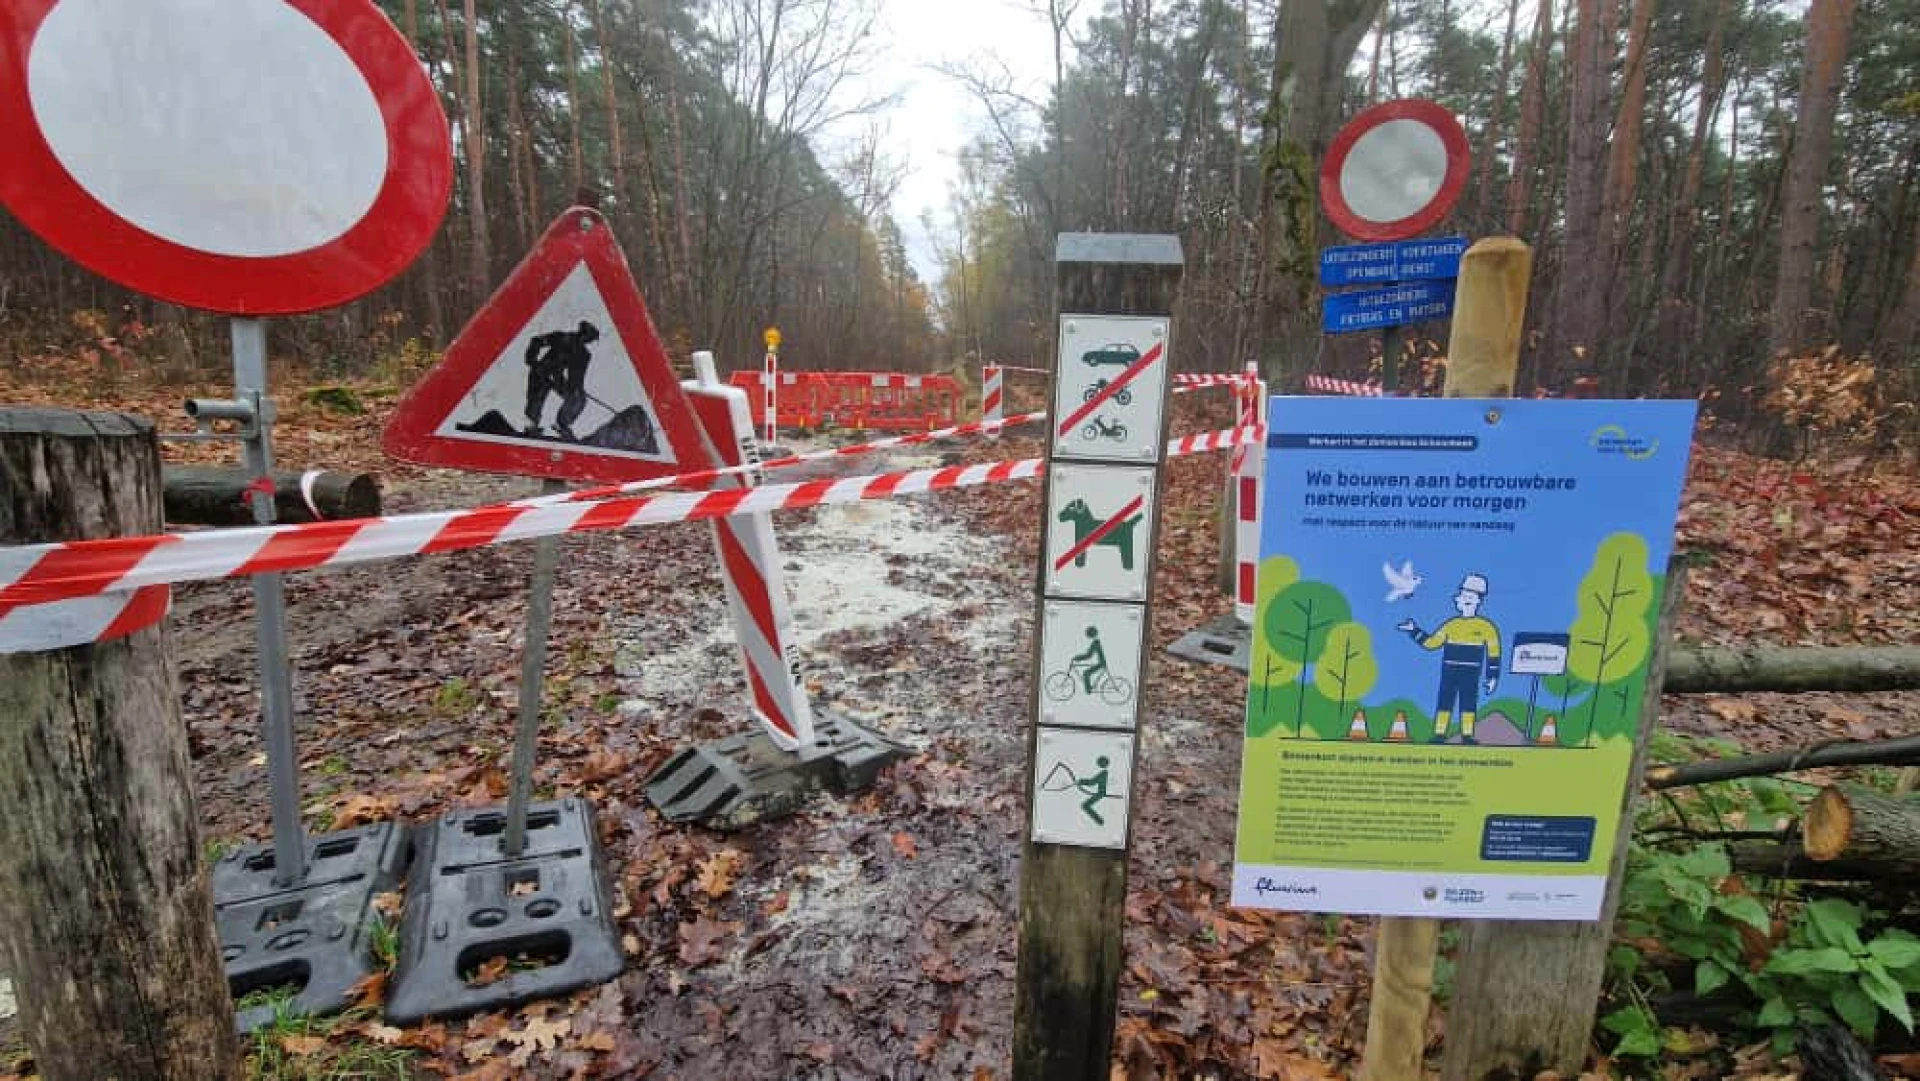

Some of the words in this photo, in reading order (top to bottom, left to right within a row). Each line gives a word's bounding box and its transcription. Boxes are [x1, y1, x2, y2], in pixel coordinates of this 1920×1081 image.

[1306, 470, 1332, 487] We
[1338, 470, 1410, 488] bouwen
[1415, 475, 1450, 488] aan
[1456, 473, 1576, 491] betrouwbare
[1305, 491, 1402, 508] netwerken
[1407, 495, 1449, 508] voor
[1453, 496, 1526, 513] morgen
